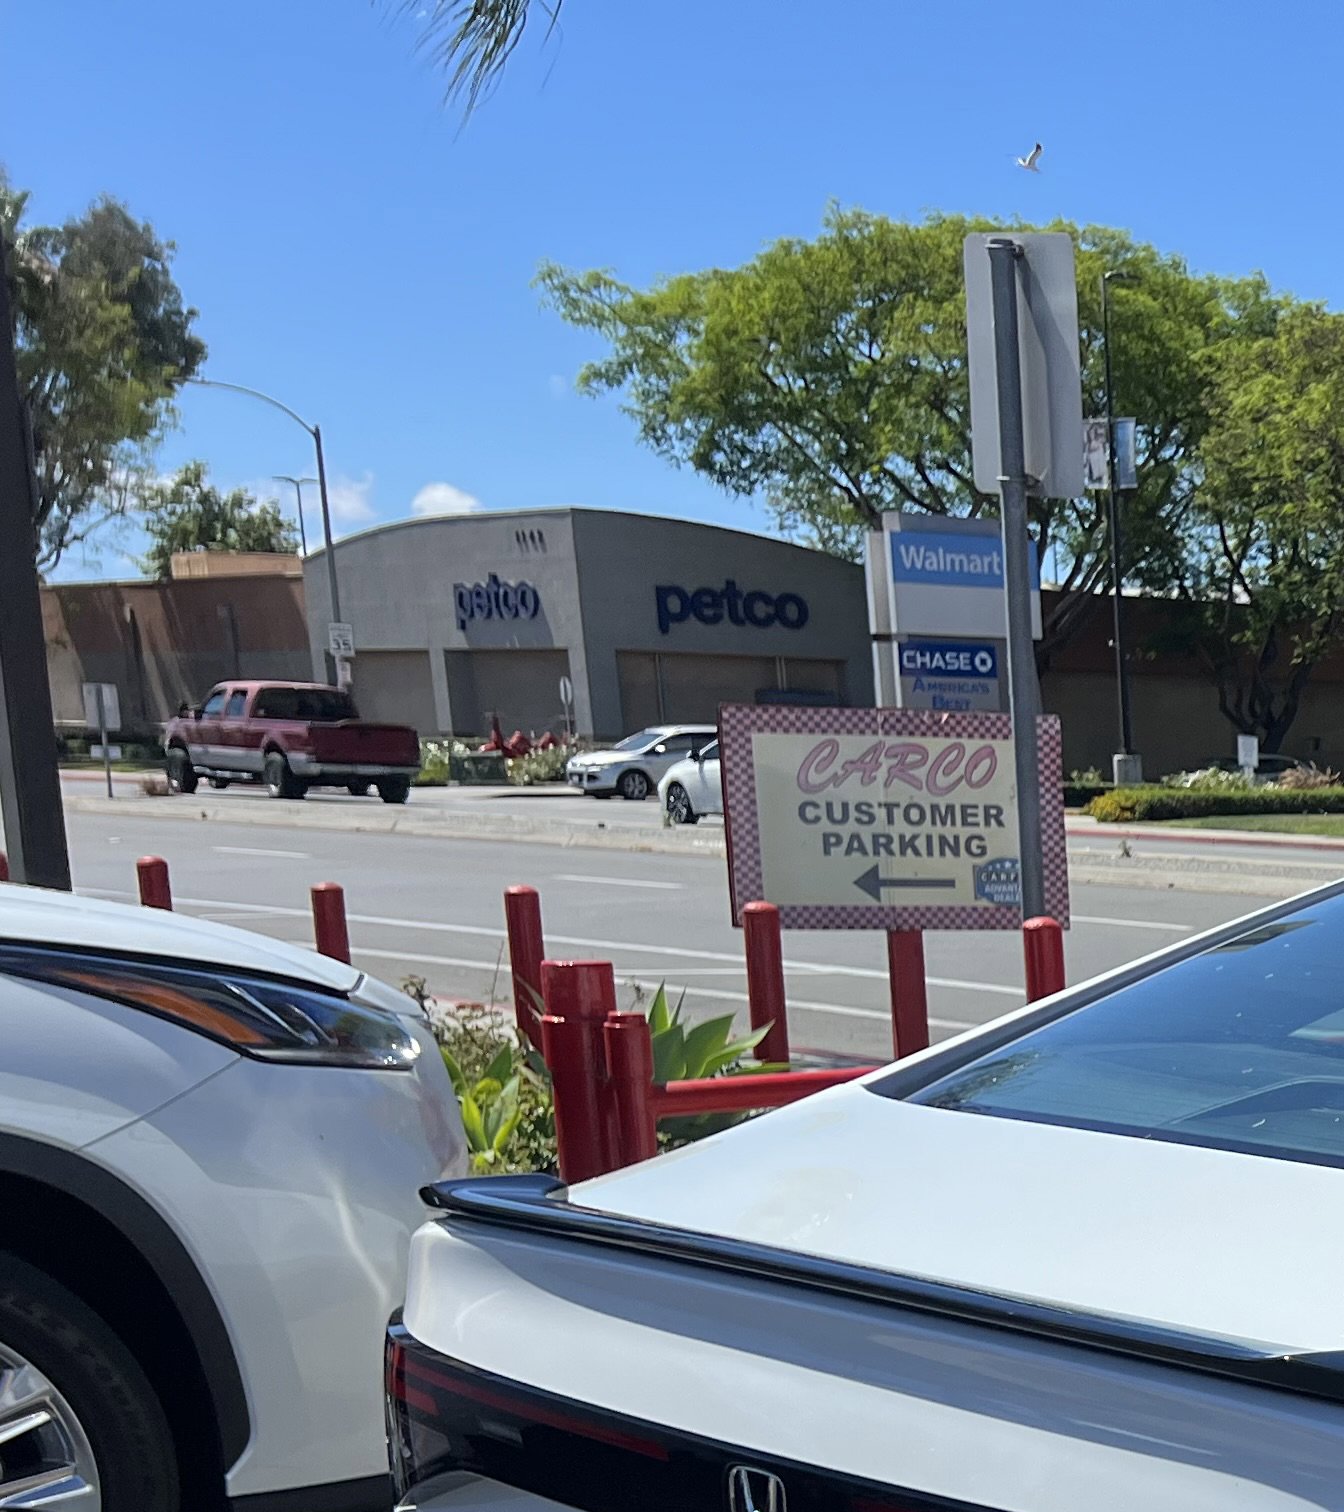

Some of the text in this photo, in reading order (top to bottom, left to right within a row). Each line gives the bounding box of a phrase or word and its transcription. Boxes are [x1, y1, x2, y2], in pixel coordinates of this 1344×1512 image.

[899, 543, 1001, 575] Walmart
[453, 571, 540, 631] petco
[655, 579, 810, 635] petco
[332, 638, 351, 651] 35
[902, 649, 972, 671] CHASE
[796, 740, 998, 795] CARCO
[798, 801, 1005, 828] CUSTOMER
[823, 832, 988, 858] PARKING
[981, 871, 1016, 882] CARF
